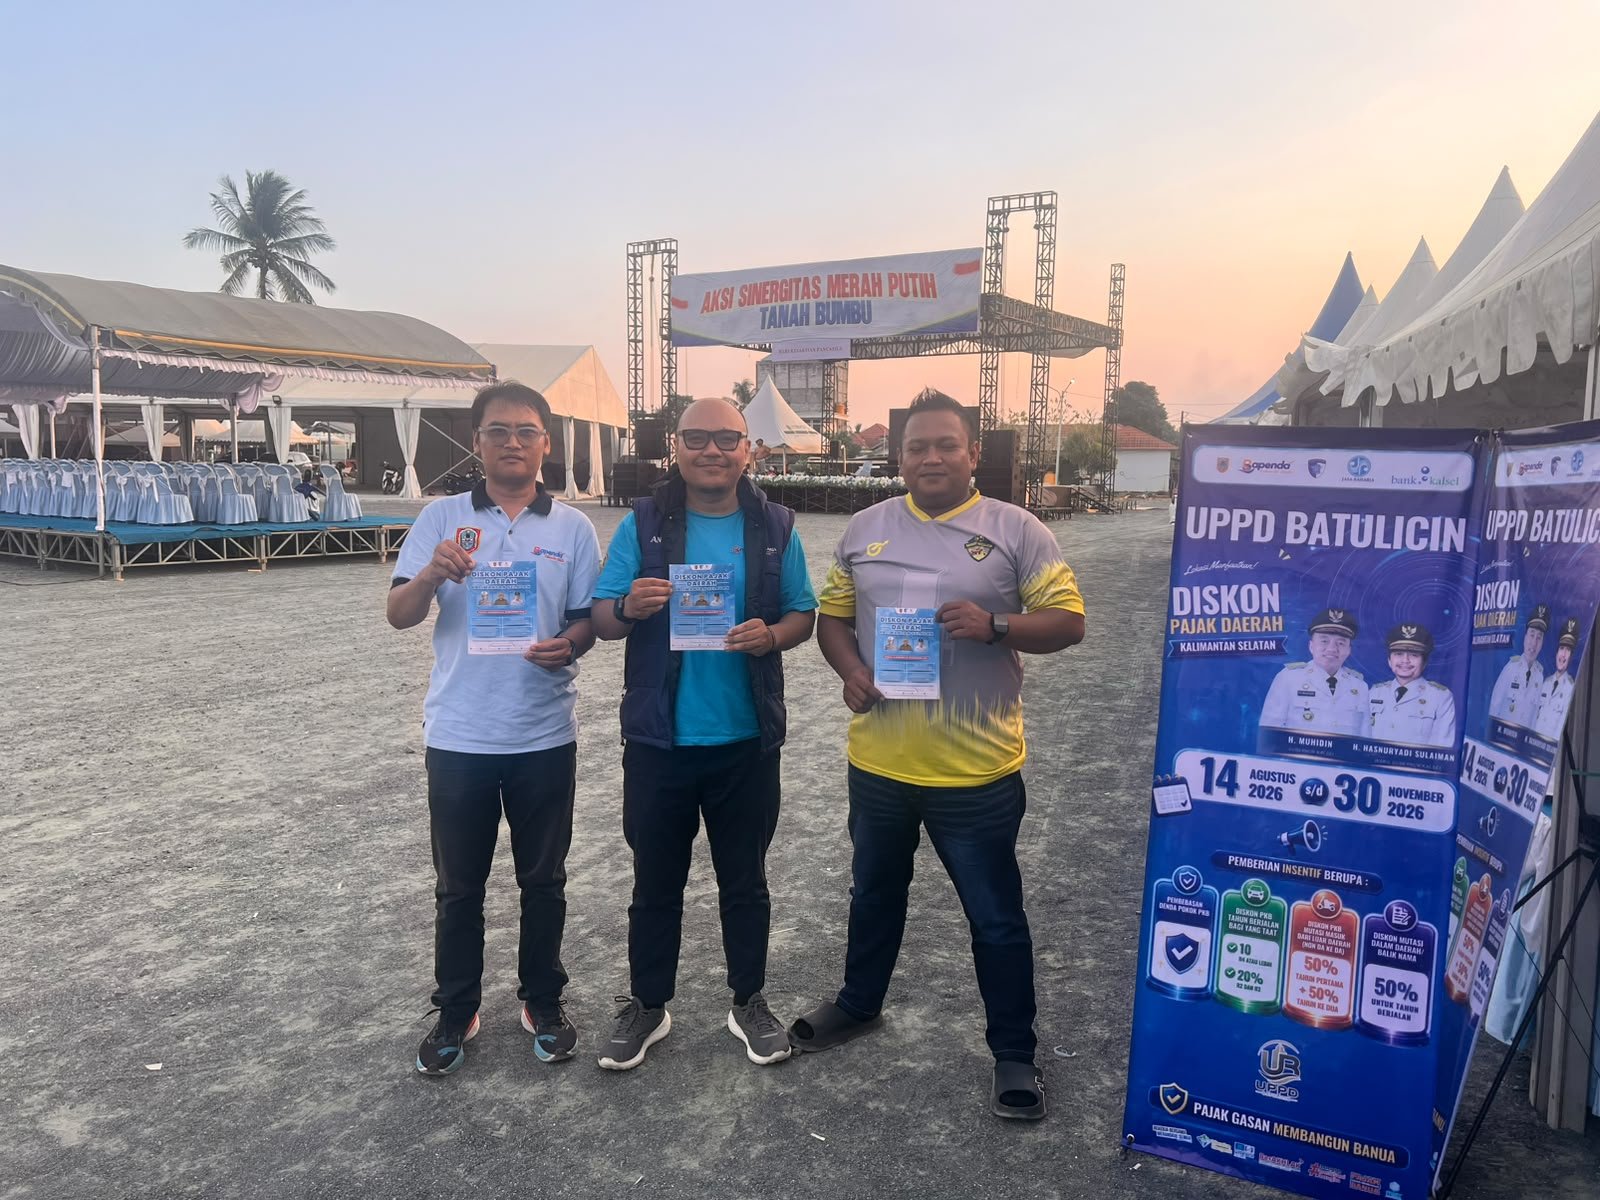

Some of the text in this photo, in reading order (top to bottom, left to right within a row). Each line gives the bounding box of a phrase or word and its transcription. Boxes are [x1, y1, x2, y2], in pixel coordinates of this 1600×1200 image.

[700, 272, 937, 314] AKSI SINERGITAS MERAH PUTIH
[760, 300, 872, 330] TANAH BUMBU
[1391, 475, 1459, 486] bank kalsel
[1185, 506, 1466, 553] UPPD BATULICIN
[1486, 509, 1528, 541] UPPD
[1173, 583, 1280, 616] DISKON
[1170, 616, 1283, 635] PAJAK DAERAH
[1180, 640, 1276, 652] KALIMANTAN SELATAN
[1288, 736, 1333, 748] H. MUHIDIN
[1353, 743, 1455, 762] H. HASNURYADI SULAIMAN
[1200, 757, 1444, 816] 14 AGUSTUS s/d 30 NOVEMBER
[1506, 764, 1529, 806] 30
[1248, 783, 1424, 820] 2026 2026
[1228, 855, 1280, 872] PEMBERIAN
[1282, 863, 1321, 878] INSENTIF
[1324, 870, 1362, 885] BERUPA
[1159, 902, 1177, 911] DENDA
[1178, 904, 1197, 915] POKOK
[1167, 896, 1203, 908] PEMBEBASAN
[1228, 914, 1279, 929] TAHUN BERJALAN
[1235, 907, 1272, 920] DISKON PKB
[1228, 922, 1278, 937] BAGI YANG TAAT
[1303, 927, 1346, 940] MUTASI MASUK
[1307, 920, 1342, 932] DISKON PKB
[1297, 933, 1351, 948] DARI LUAR DAERAH
[1371, 940, 1393, 950] DALAM
[1373, 932, 1424, 948] DISKON MUTASI
[1239, 943, 1252, 956] 10
[1326, 945, 1334, 953] KE
[1377, 949, 1417, 962] BALIK NAMA
[1304, 955, 1338, 976] 50%
[1237, 969, 1263, 985] 20%
[1295, 973, 1344, 988] TAHUN PERTAMA
[1308, 985, 1339, 1004] 50%
[1374, 977, 1418, 1003] 50%
[1297, 998, 1339, 1013] TAHUN KE DUA
[1371, 998, 1419, 1014] UNTUK TAHUN
[1377, 1009, 1411, 1021] BERJALAN
[1255, 1080, 1299, 1098] UPPD
[1193, 1101, 1395, 1164] PAJAK GASAN MEMBANGUN BANUA
